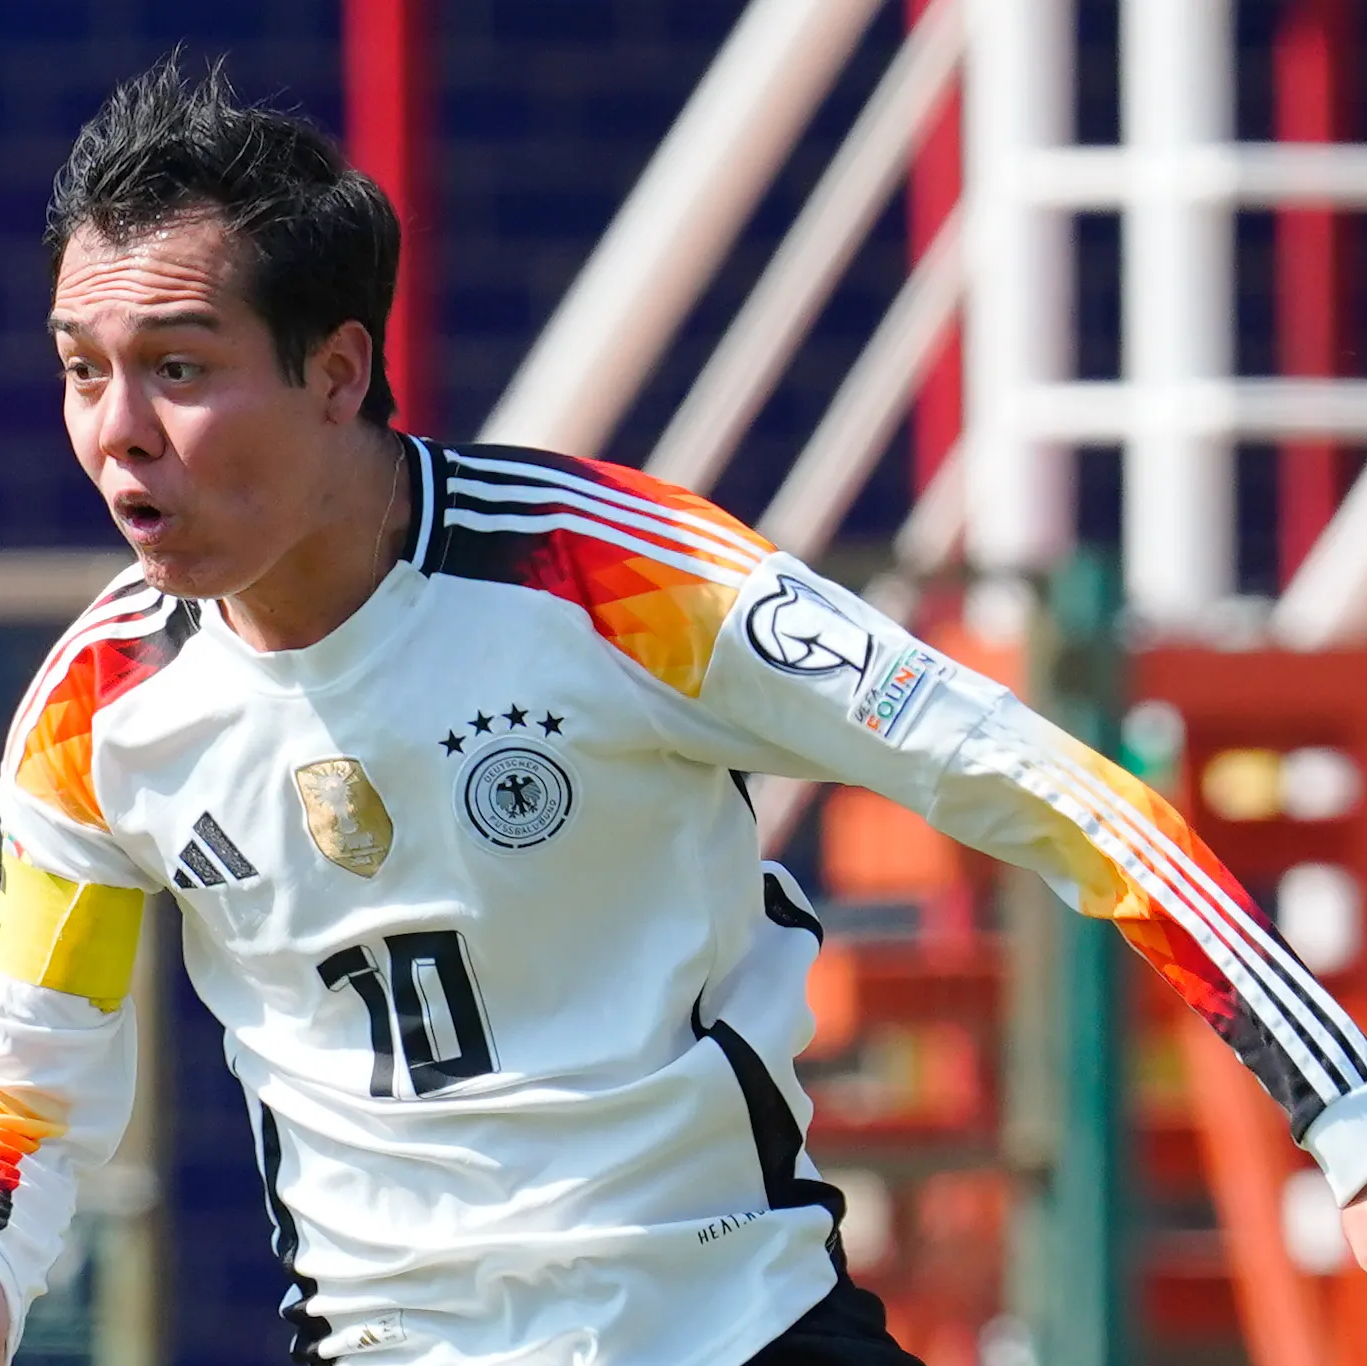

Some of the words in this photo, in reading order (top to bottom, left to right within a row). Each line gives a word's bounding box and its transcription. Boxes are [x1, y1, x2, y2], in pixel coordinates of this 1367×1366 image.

[854, 687, 880, 723] UEFA
[484, 759, 539, 783] DEUTSCHER
[316, 930, 501, 1100] 10
